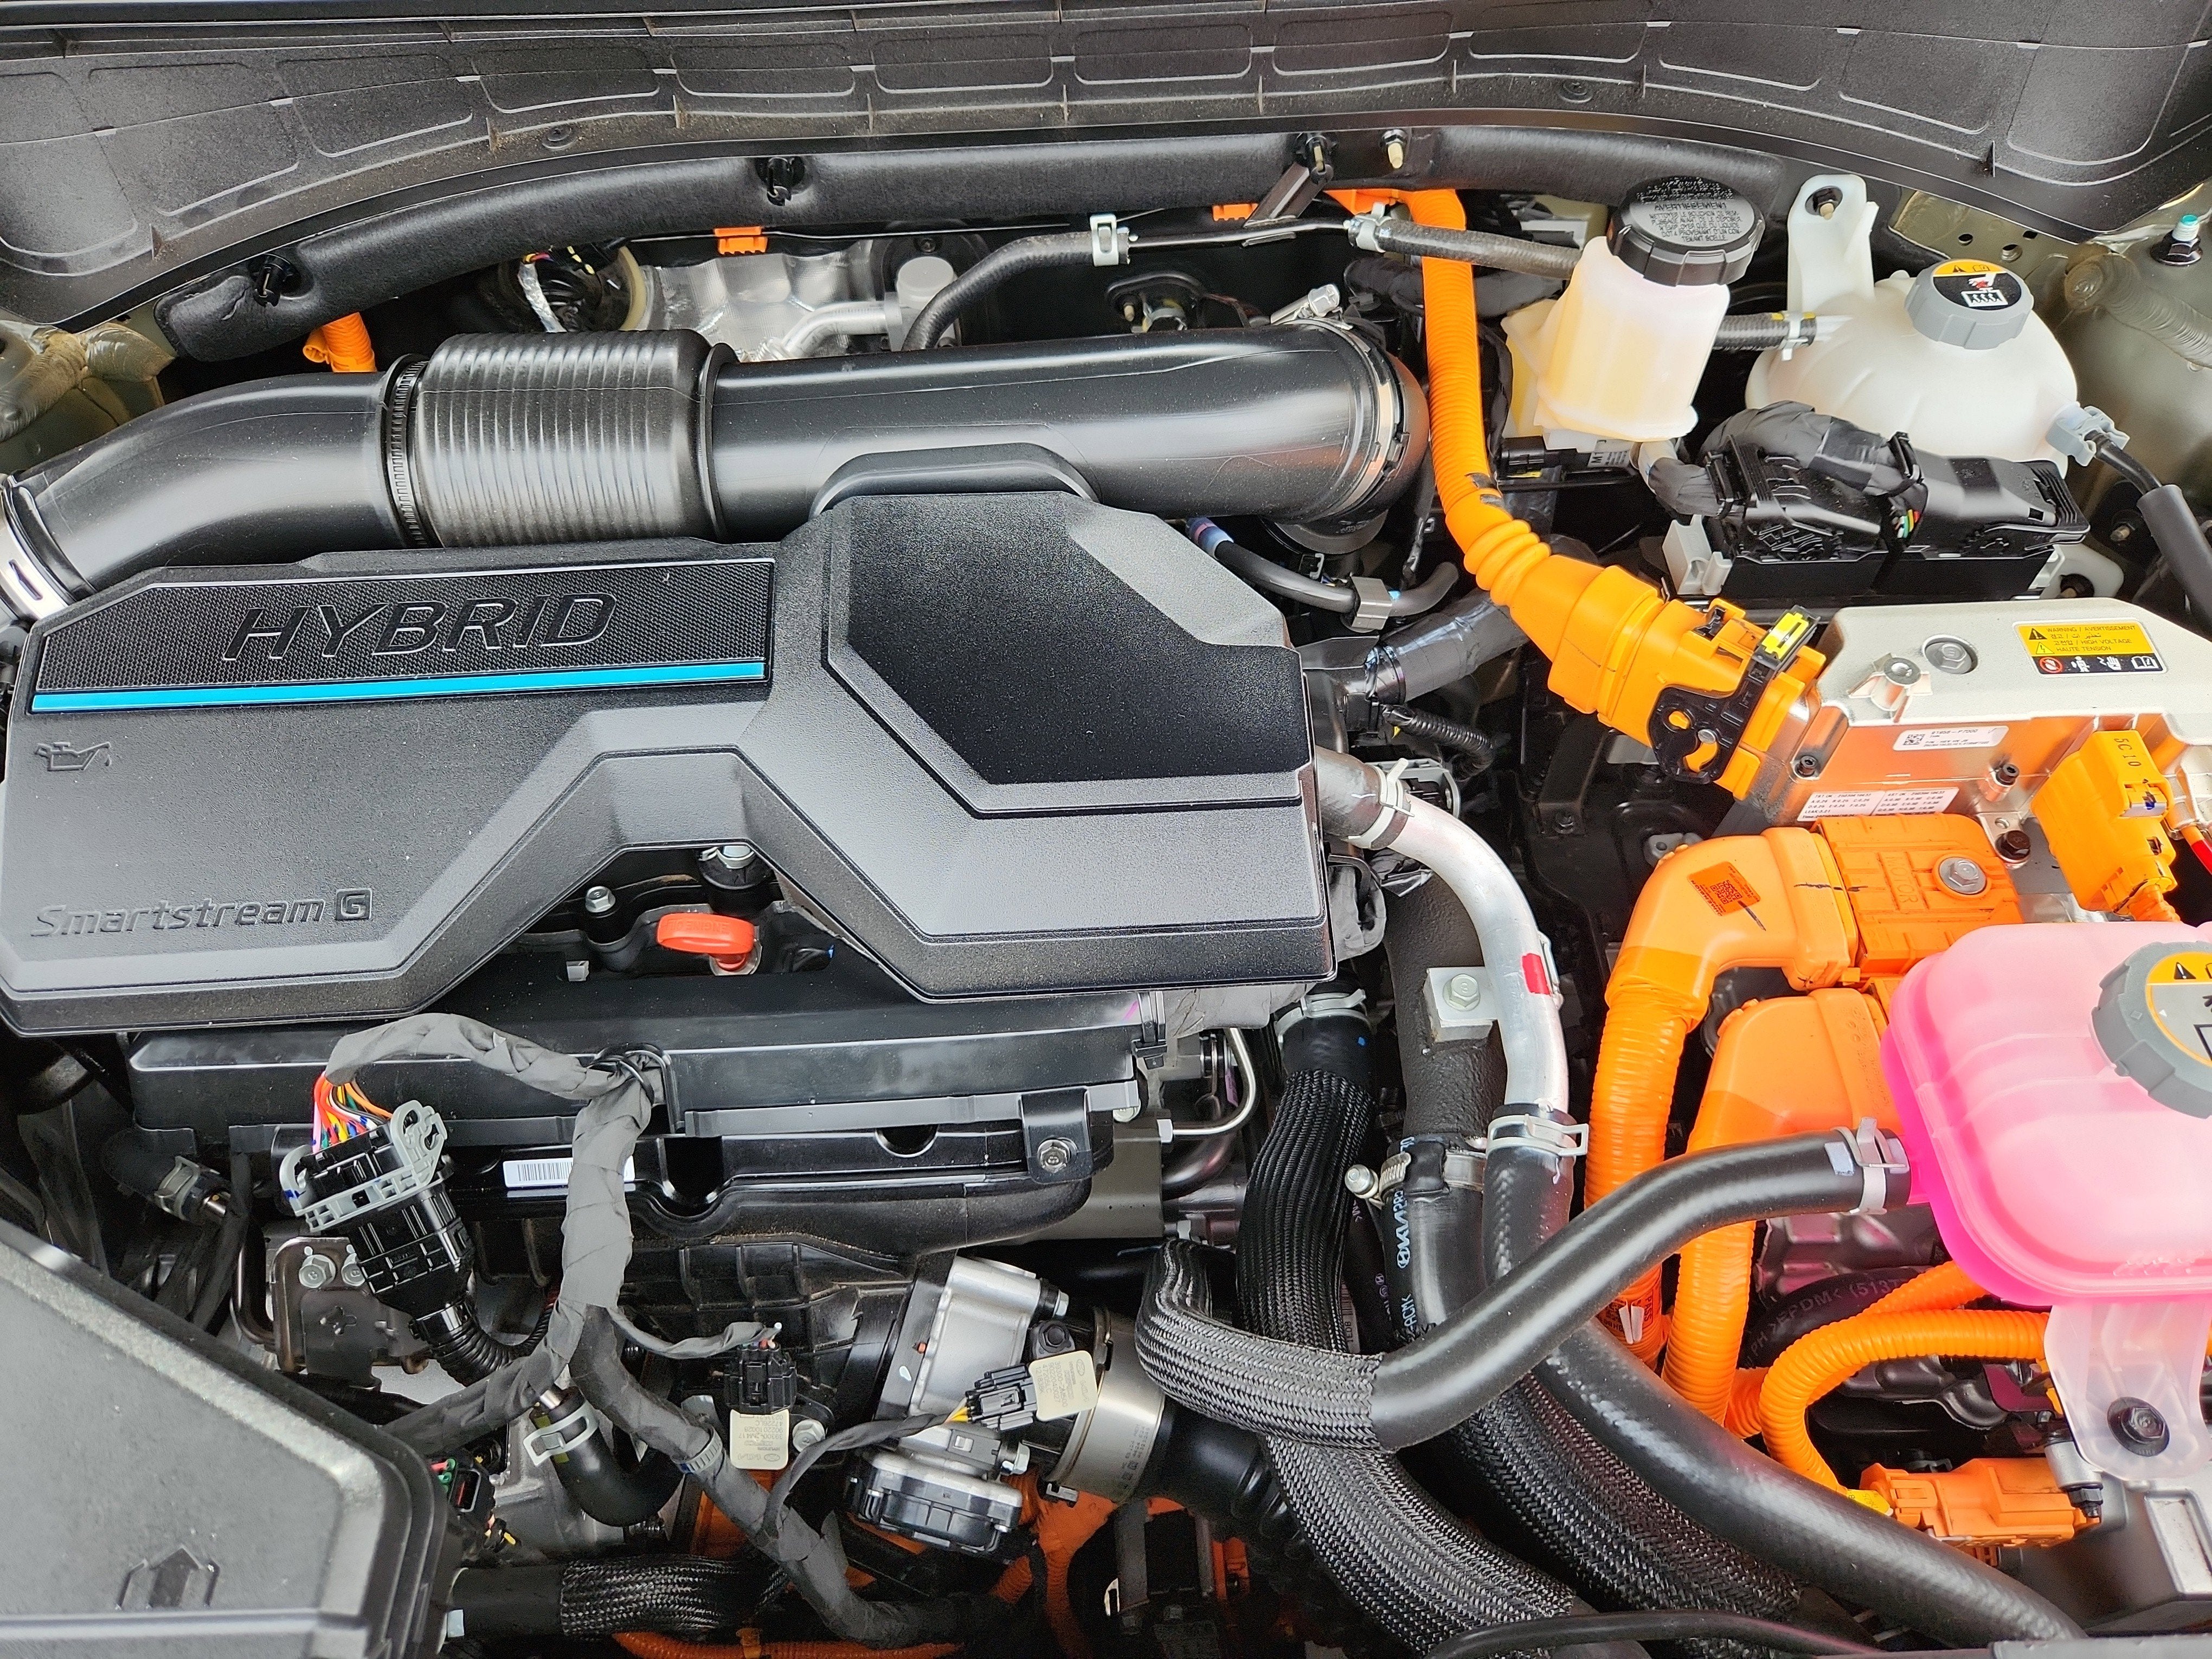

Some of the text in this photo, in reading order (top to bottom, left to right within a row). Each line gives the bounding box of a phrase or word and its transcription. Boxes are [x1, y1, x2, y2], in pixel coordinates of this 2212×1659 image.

[223, 592, 617, 661] HYBRID
[30, 891, 369, 937] Smartstream G
